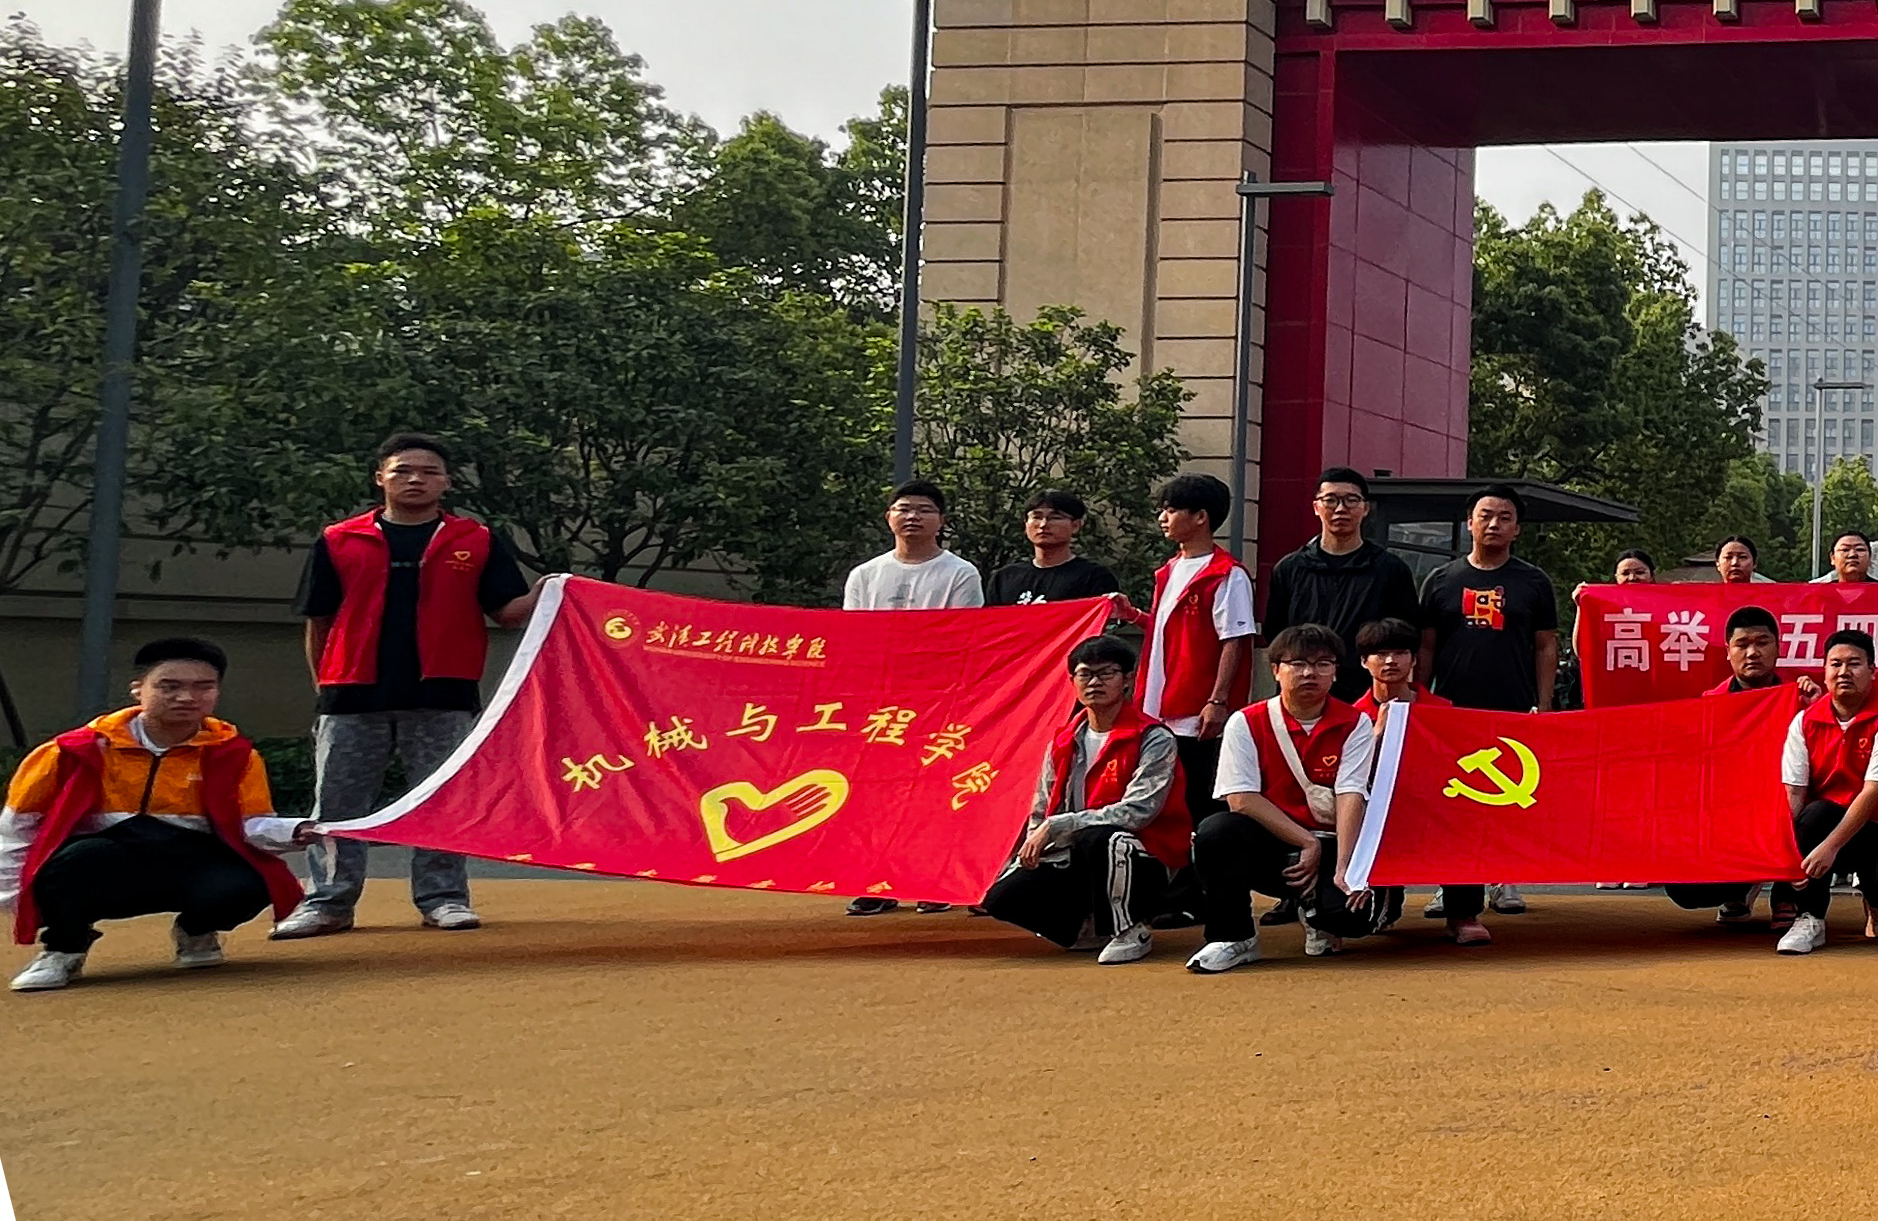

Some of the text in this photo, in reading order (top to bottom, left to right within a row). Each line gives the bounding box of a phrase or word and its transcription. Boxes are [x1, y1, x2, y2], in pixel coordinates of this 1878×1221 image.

[561, 702, 1000, 811] 机械与工程学院
